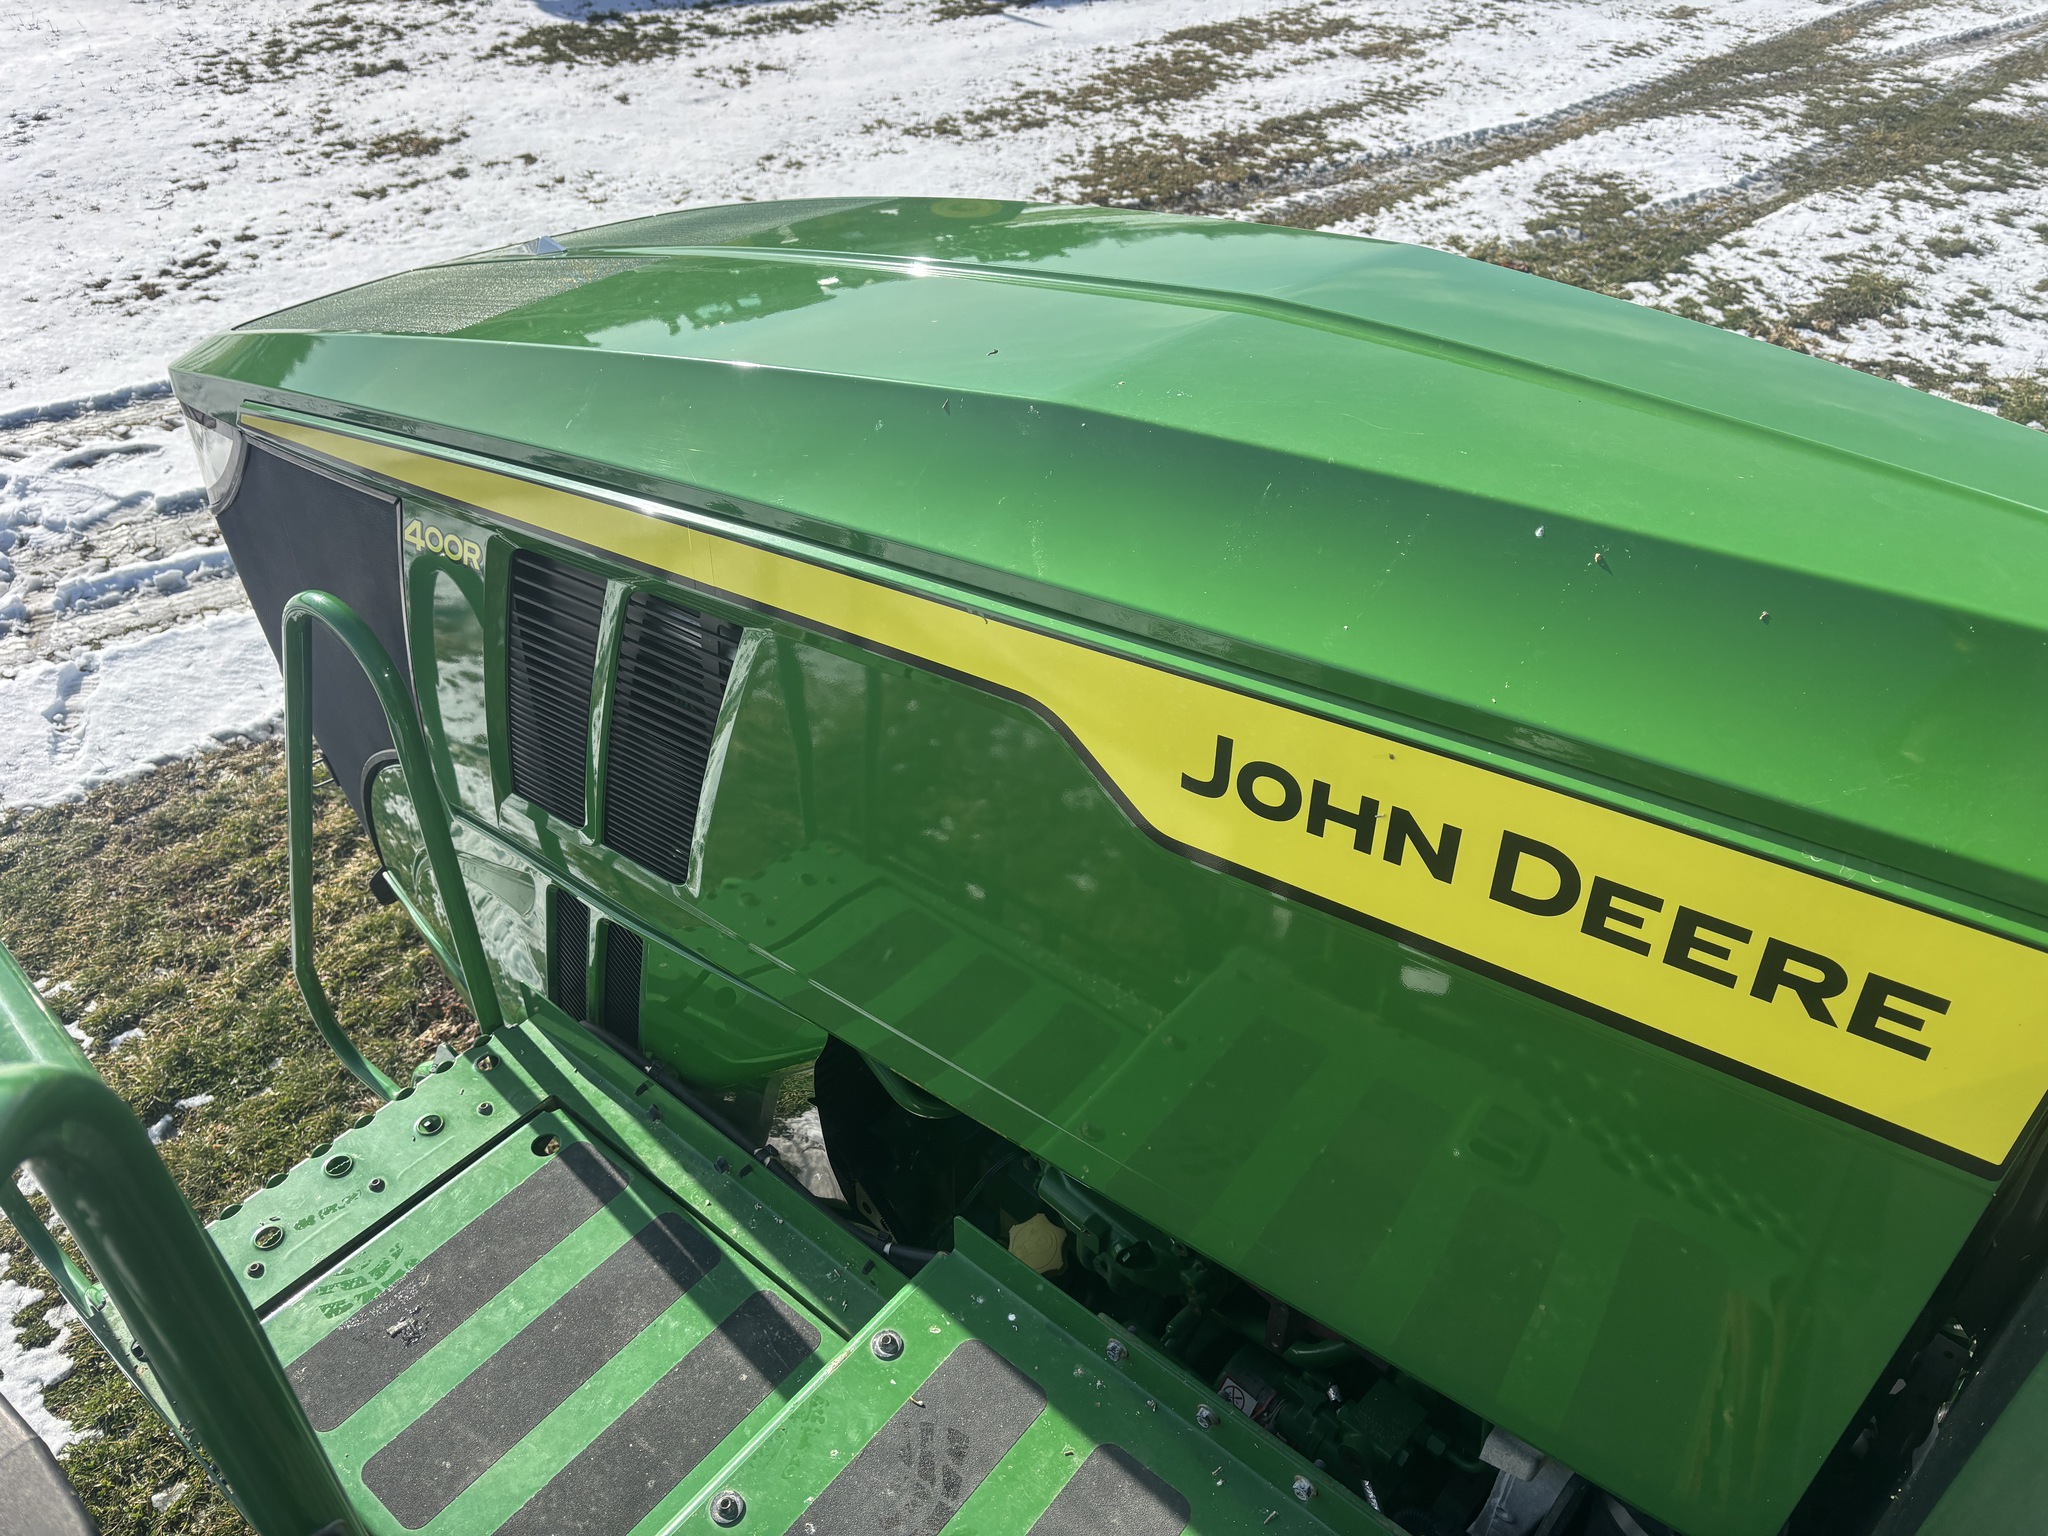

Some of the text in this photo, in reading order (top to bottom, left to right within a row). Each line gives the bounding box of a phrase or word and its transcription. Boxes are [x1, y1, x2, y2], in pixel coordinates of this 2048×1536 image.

[404, 520, 480, 571] 400R
[1180, 734, 1952, 1062] JOHN DEERE
